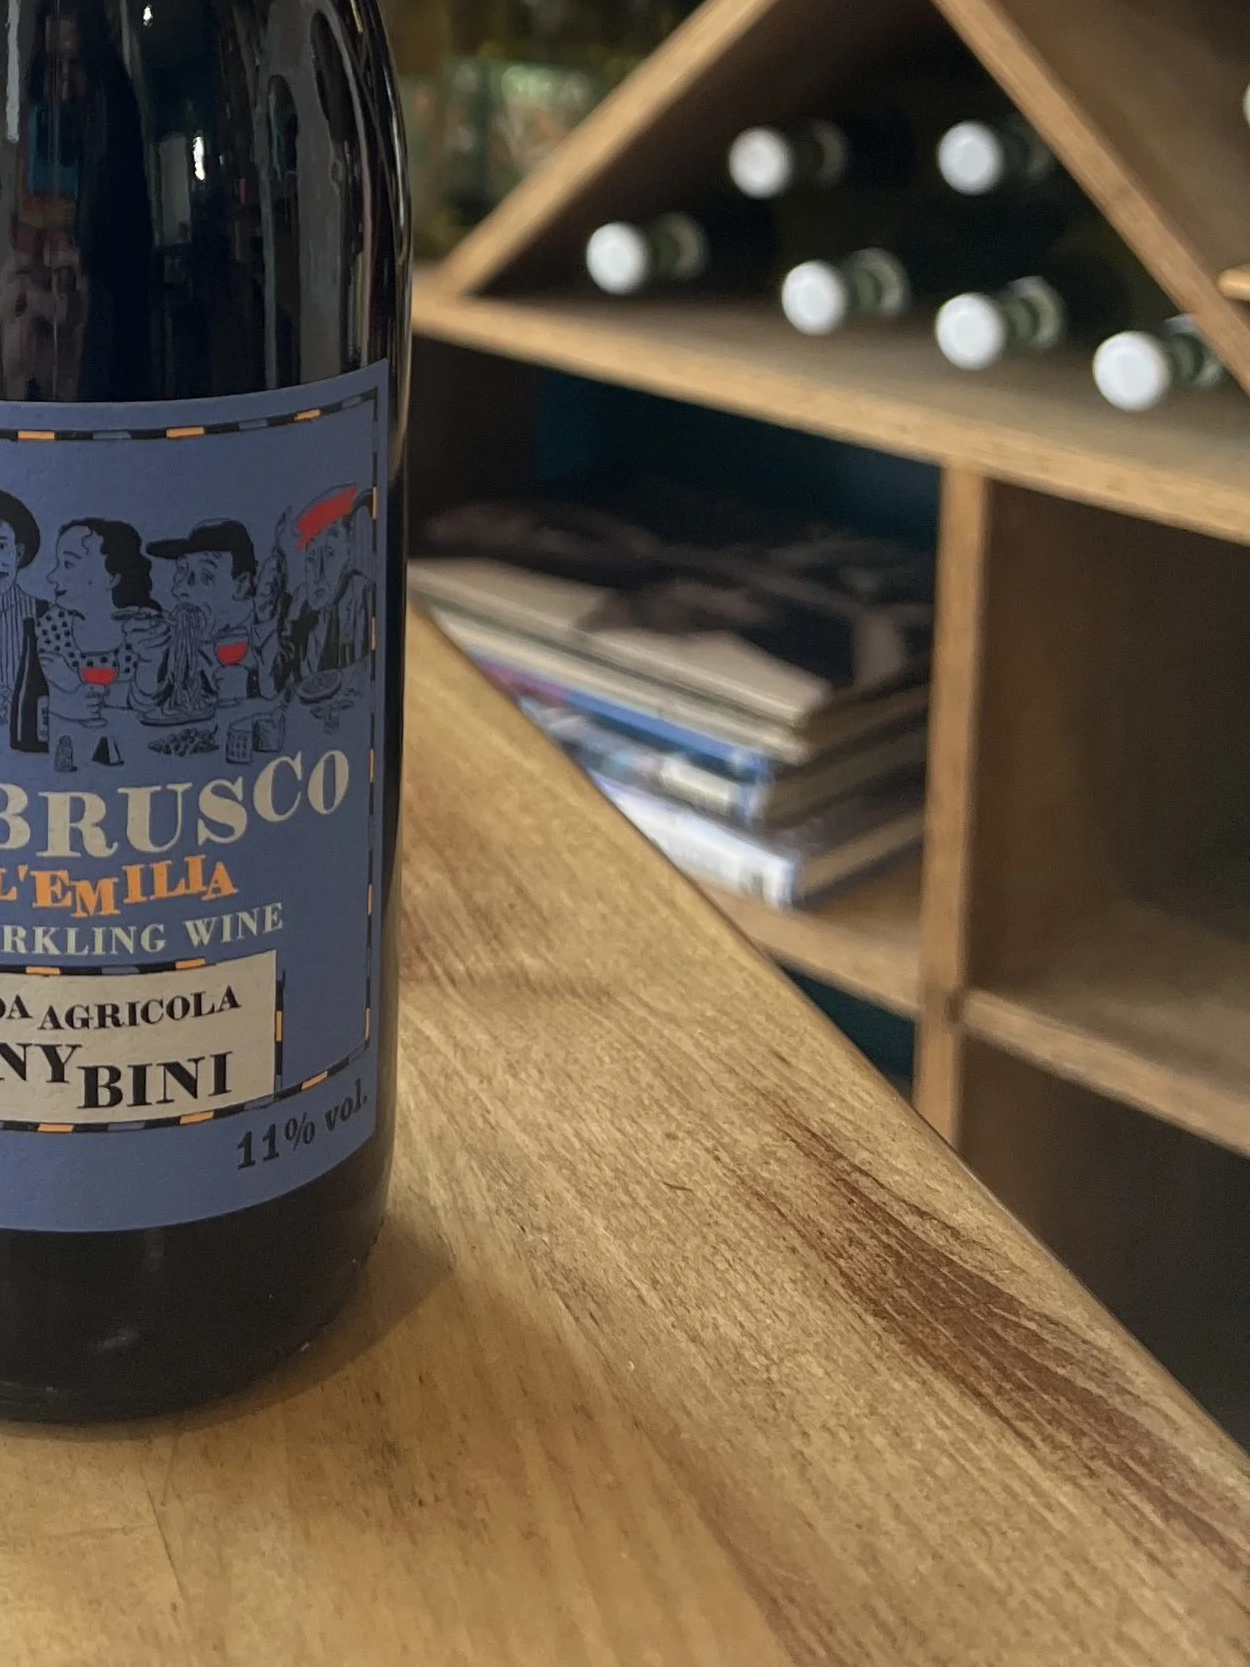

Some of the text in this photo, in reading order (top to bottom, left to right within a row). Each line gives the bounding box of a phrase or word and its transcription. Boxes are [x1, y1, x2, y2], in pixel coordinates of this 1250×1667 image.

[185, 902, 285, 945] WINE
[39, 983, 243, 1032] AGRICOLA
[77, 1051, 234, 1112] BINI
[237, 1078, 368, 1170] 11% vol.
